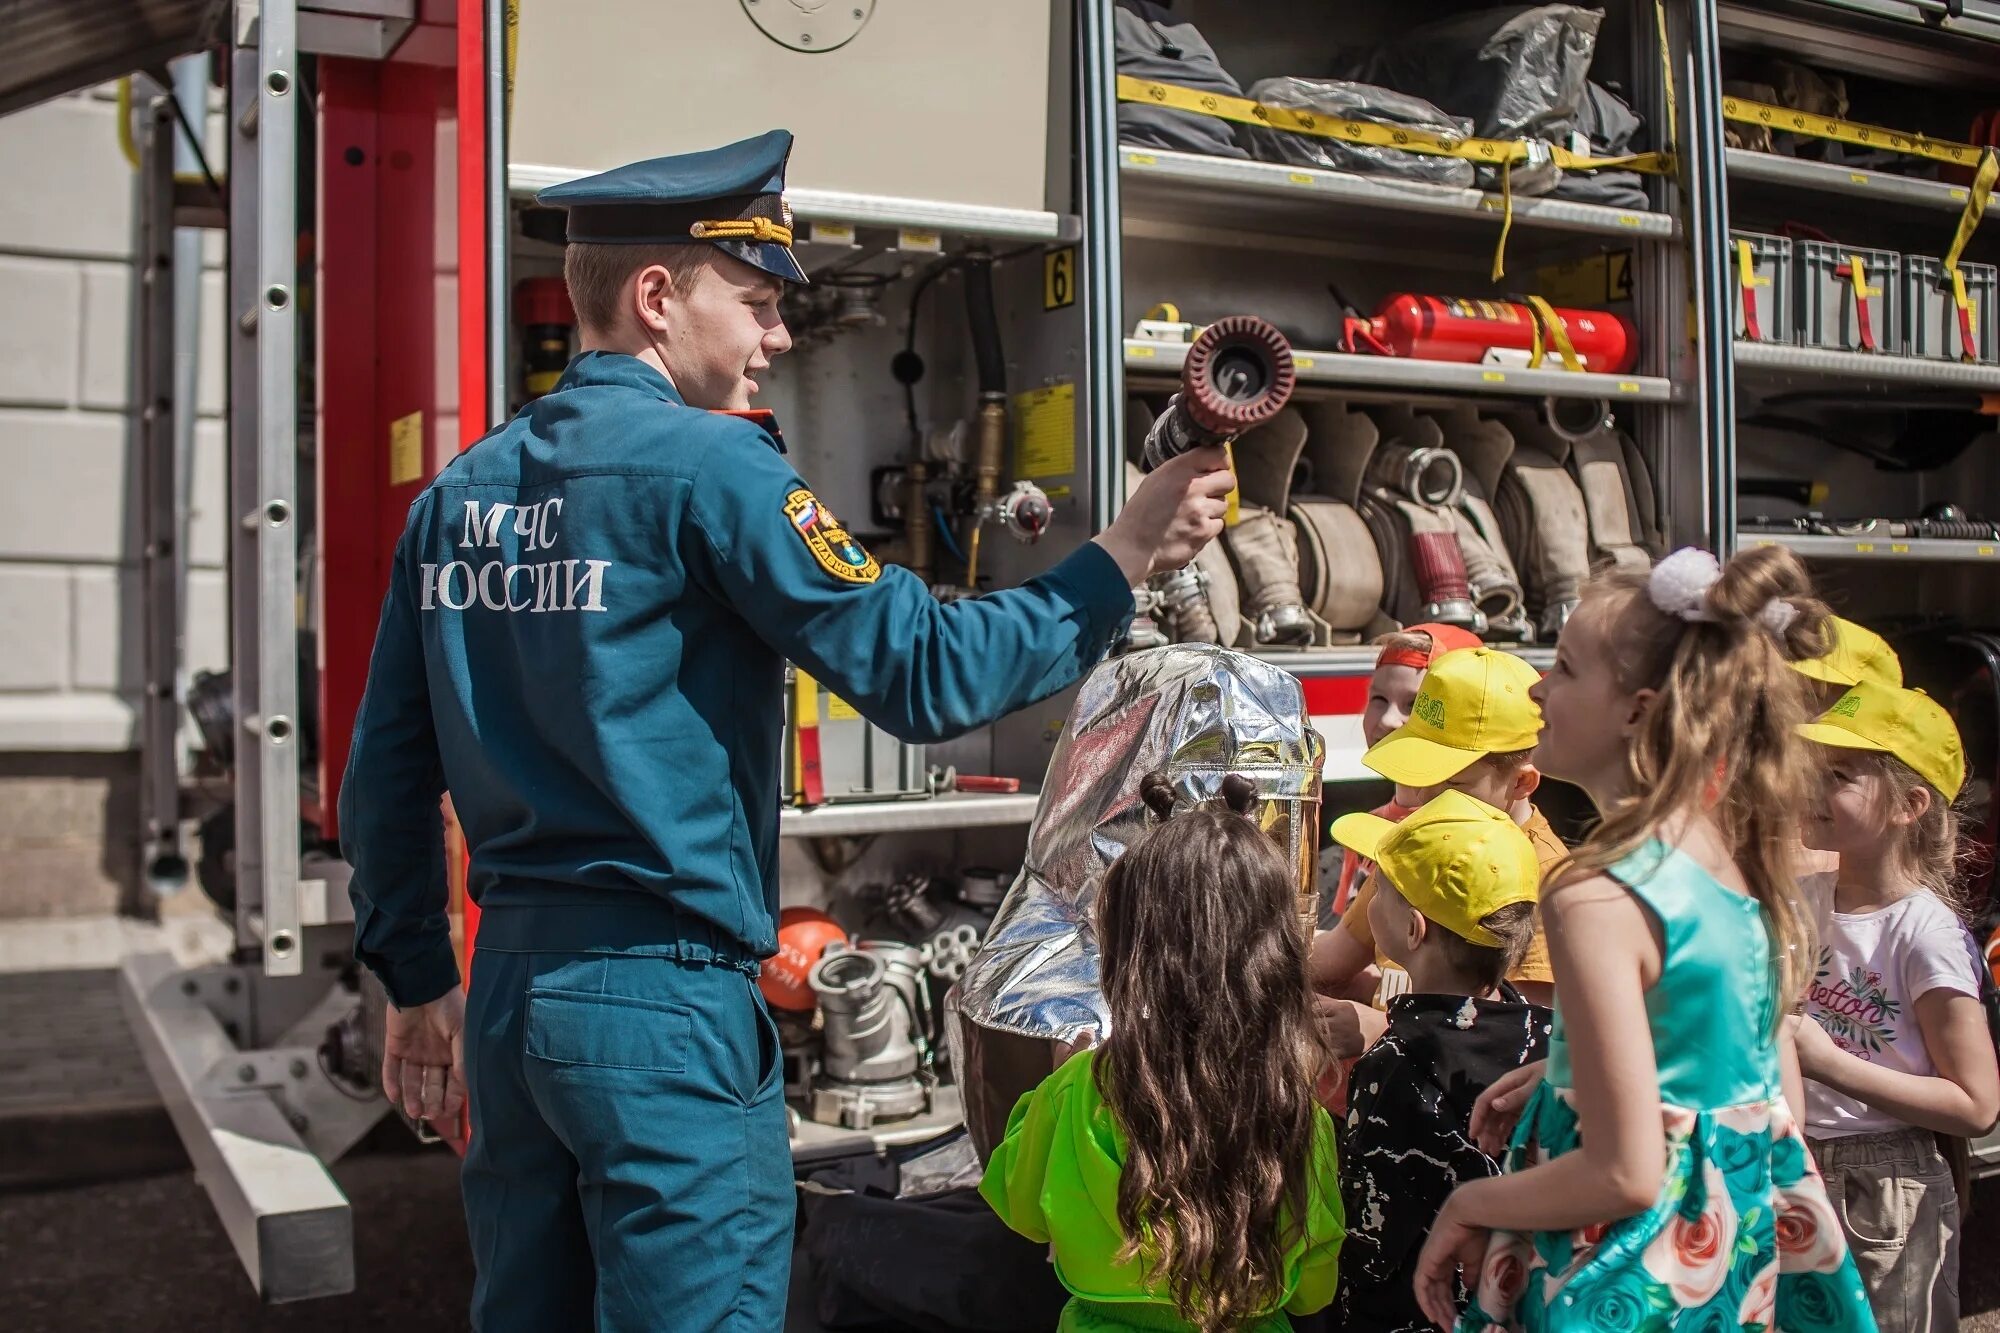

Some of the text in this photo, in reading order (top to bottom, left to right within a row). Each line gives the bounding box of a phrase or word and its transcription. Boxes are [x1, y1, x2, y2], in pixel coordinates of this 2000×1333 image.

[1053, 253, 1067, 303] 6
[459, 497, 564, 552] МЧС
[810, 536, 857, 578] ГЛАВНОЕ
